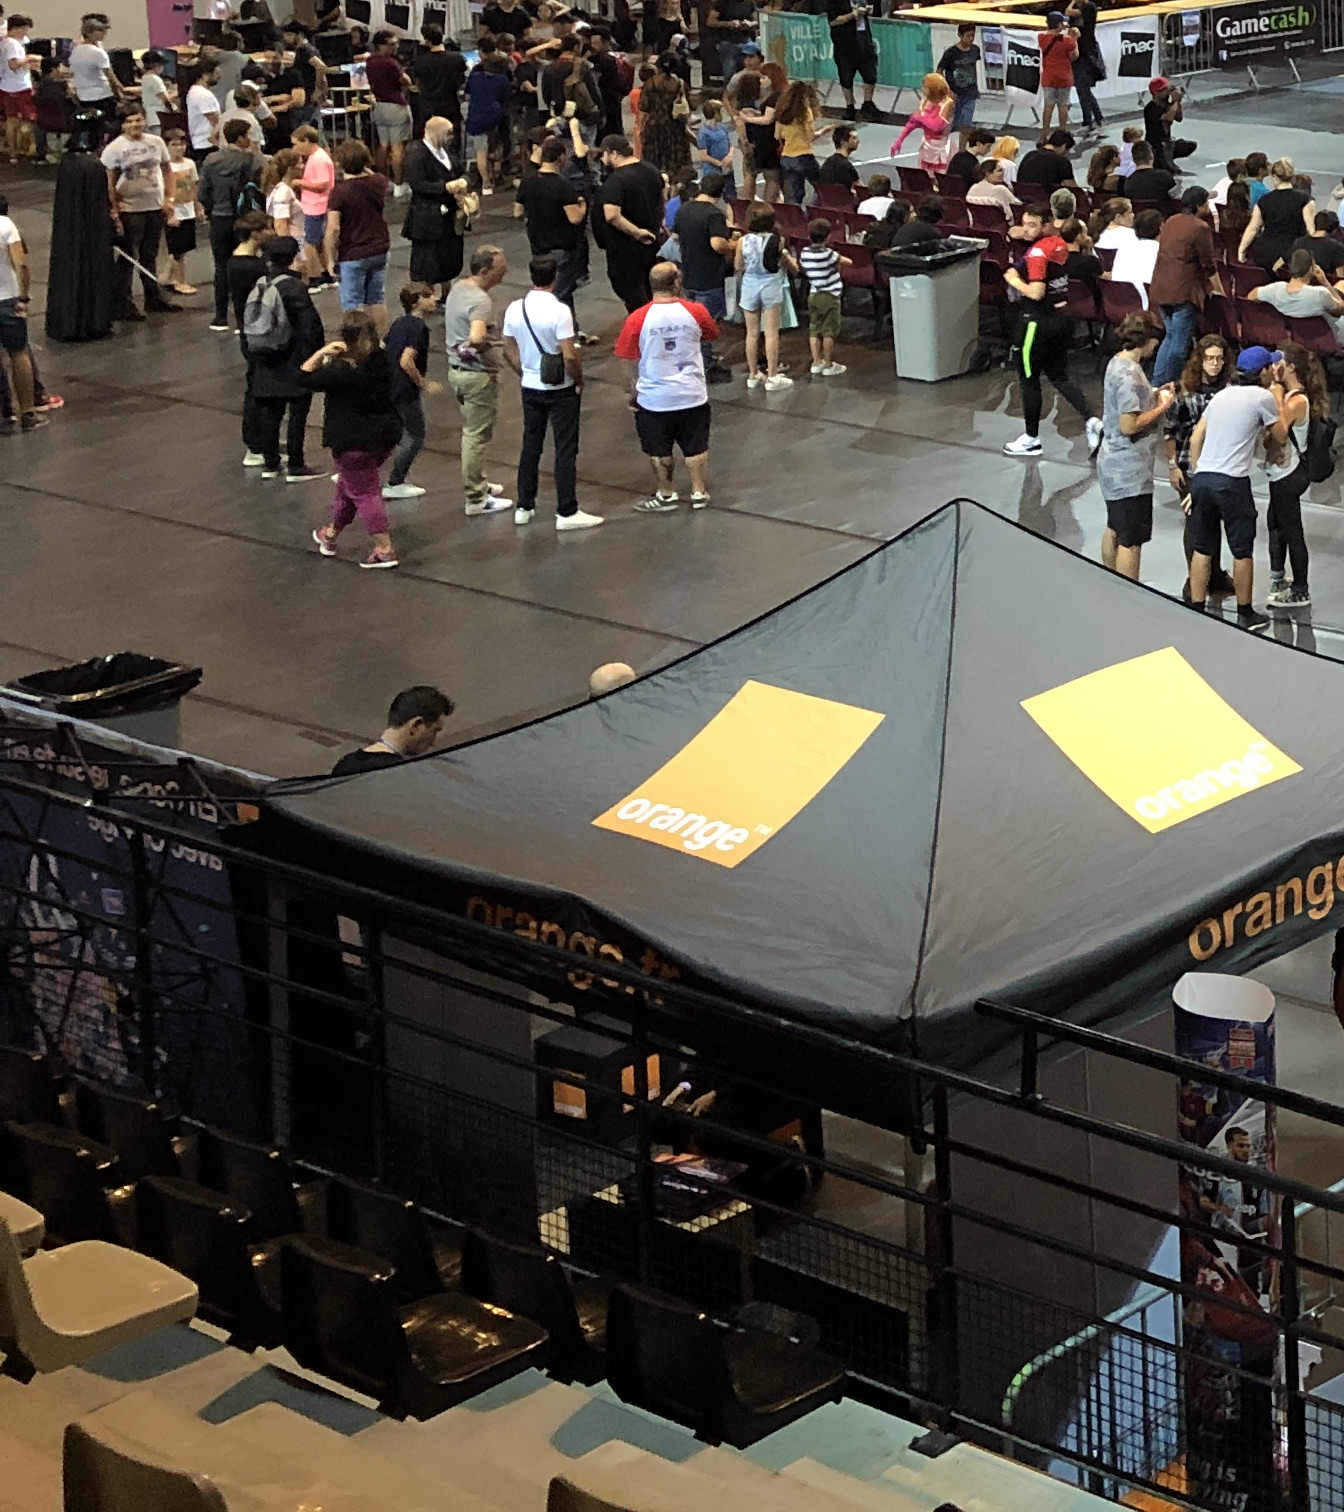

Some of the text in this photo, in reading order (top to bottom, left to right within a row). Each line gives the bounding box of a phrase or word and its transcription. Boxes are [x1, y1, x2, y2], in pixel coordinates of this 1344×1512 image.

[789, 23, 823, 39] VILLE
[1215, 5, 1310, 39] Gamecash
[1006, 49, 1041, 68] fnac
[1121, 39, 1156, 56] fnac
[1133, 750, 1274, 820] orange
[616, 797, 750, 851] orange
